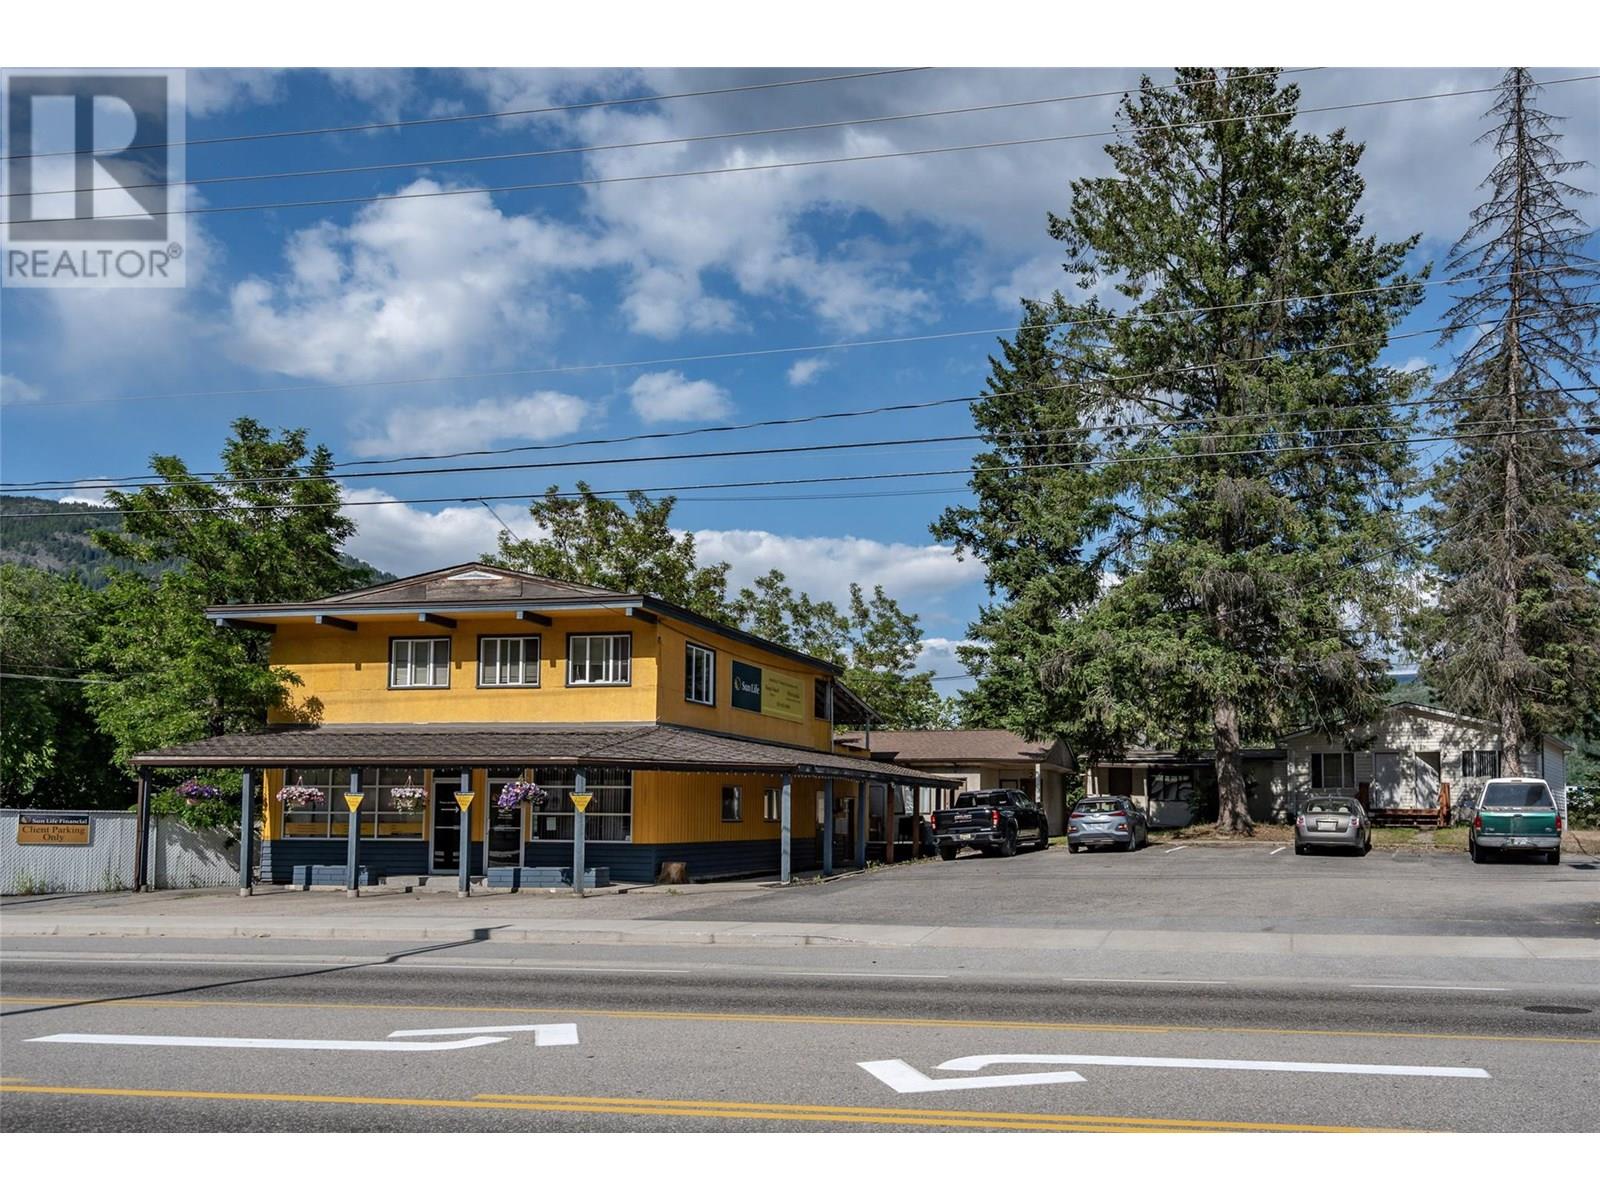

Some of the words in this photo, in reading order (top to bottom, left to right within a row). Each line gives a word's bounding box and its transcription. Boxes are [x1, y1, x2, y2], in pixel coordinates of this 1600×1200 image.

[741, 681, 751, 692] Sun
[751, 683, 760, 695] Life
[22, 825, 49, 833] Client
[52, 825, 86, 835] Parking
[42, 833, 64, 842] Only
